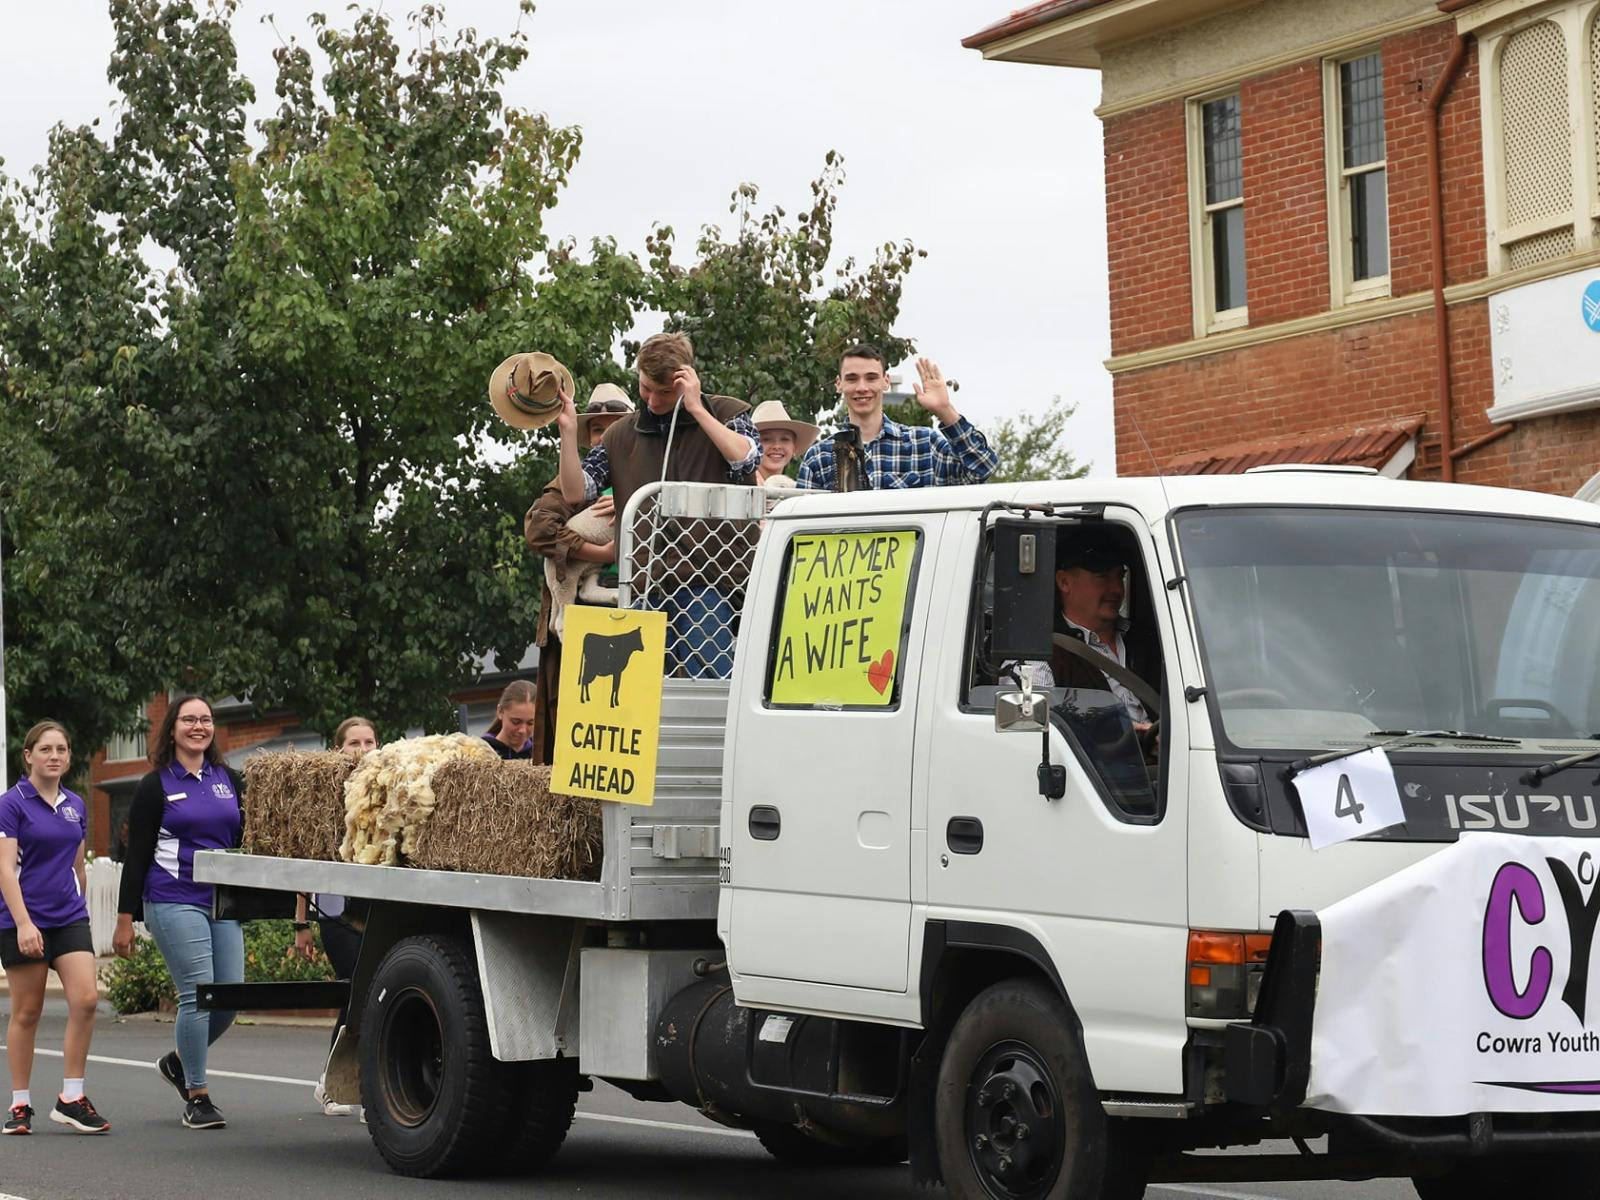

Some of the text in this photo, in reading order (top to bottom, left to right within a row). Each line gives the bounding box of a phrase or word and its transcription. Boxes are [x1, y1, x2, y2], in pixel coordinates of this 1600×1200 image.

[792, 537, 900, 585] FARMER
[804, 574, 883, 619] WANTS
[777, 617, 873, 681] A WIFE
[571, 722, 642, 755] CATTLE
[569, 762, 635, 795] AHEAD
[1335, 773, 1364, 824] 4
[1476, 1031, 1600, 1053] Cowra Youth
